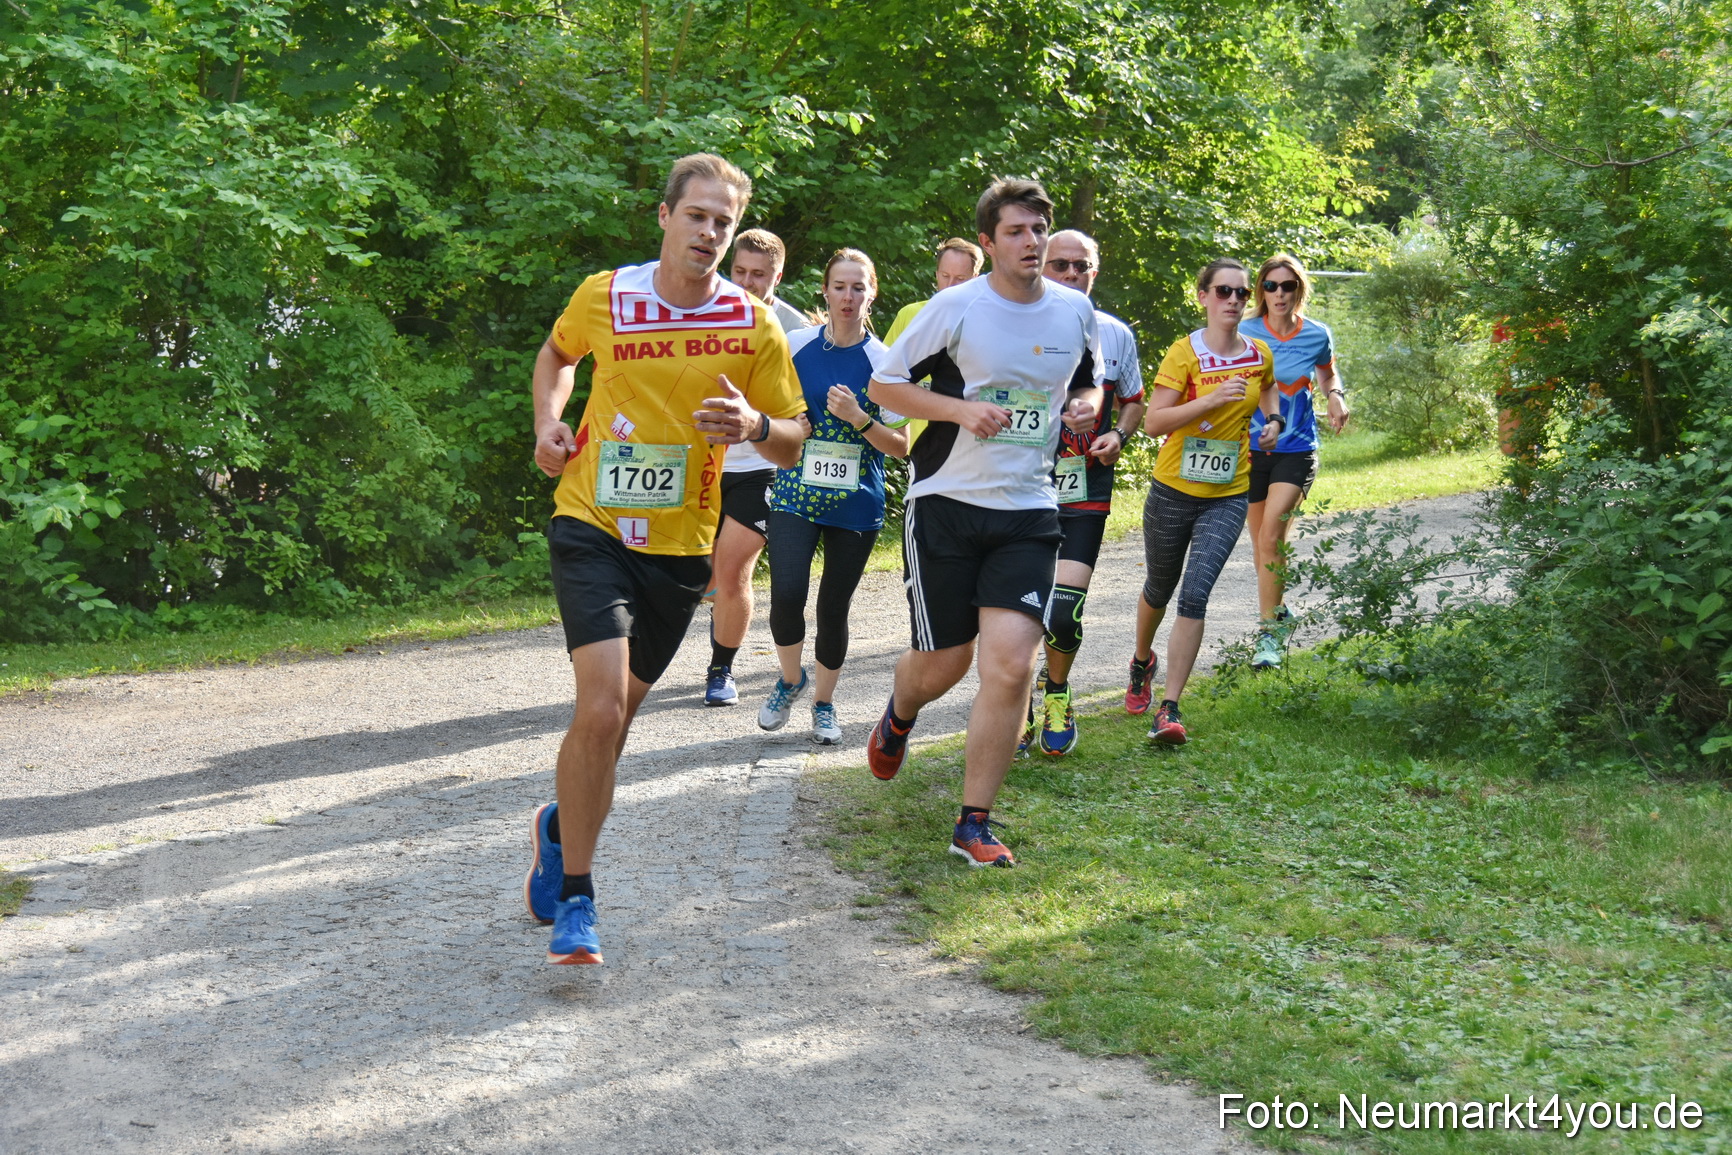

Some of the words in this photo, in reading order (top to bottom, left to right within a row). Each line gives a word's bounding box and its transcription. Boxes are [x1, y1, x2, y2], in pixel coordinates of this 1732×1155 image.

[613, 340, 676, 362] MAX
[685, 334, 756, 357] BÖGL
[1201, 374, 1230, 386] MAX
[814, 460, 847, 478] 9139
[1189, 452, 1231, 472] 1706
[608, 465, 674, 491] 1702
[614, 490, 646, 498] Wittmann
[1020, 596, 1042, 609] adidas
